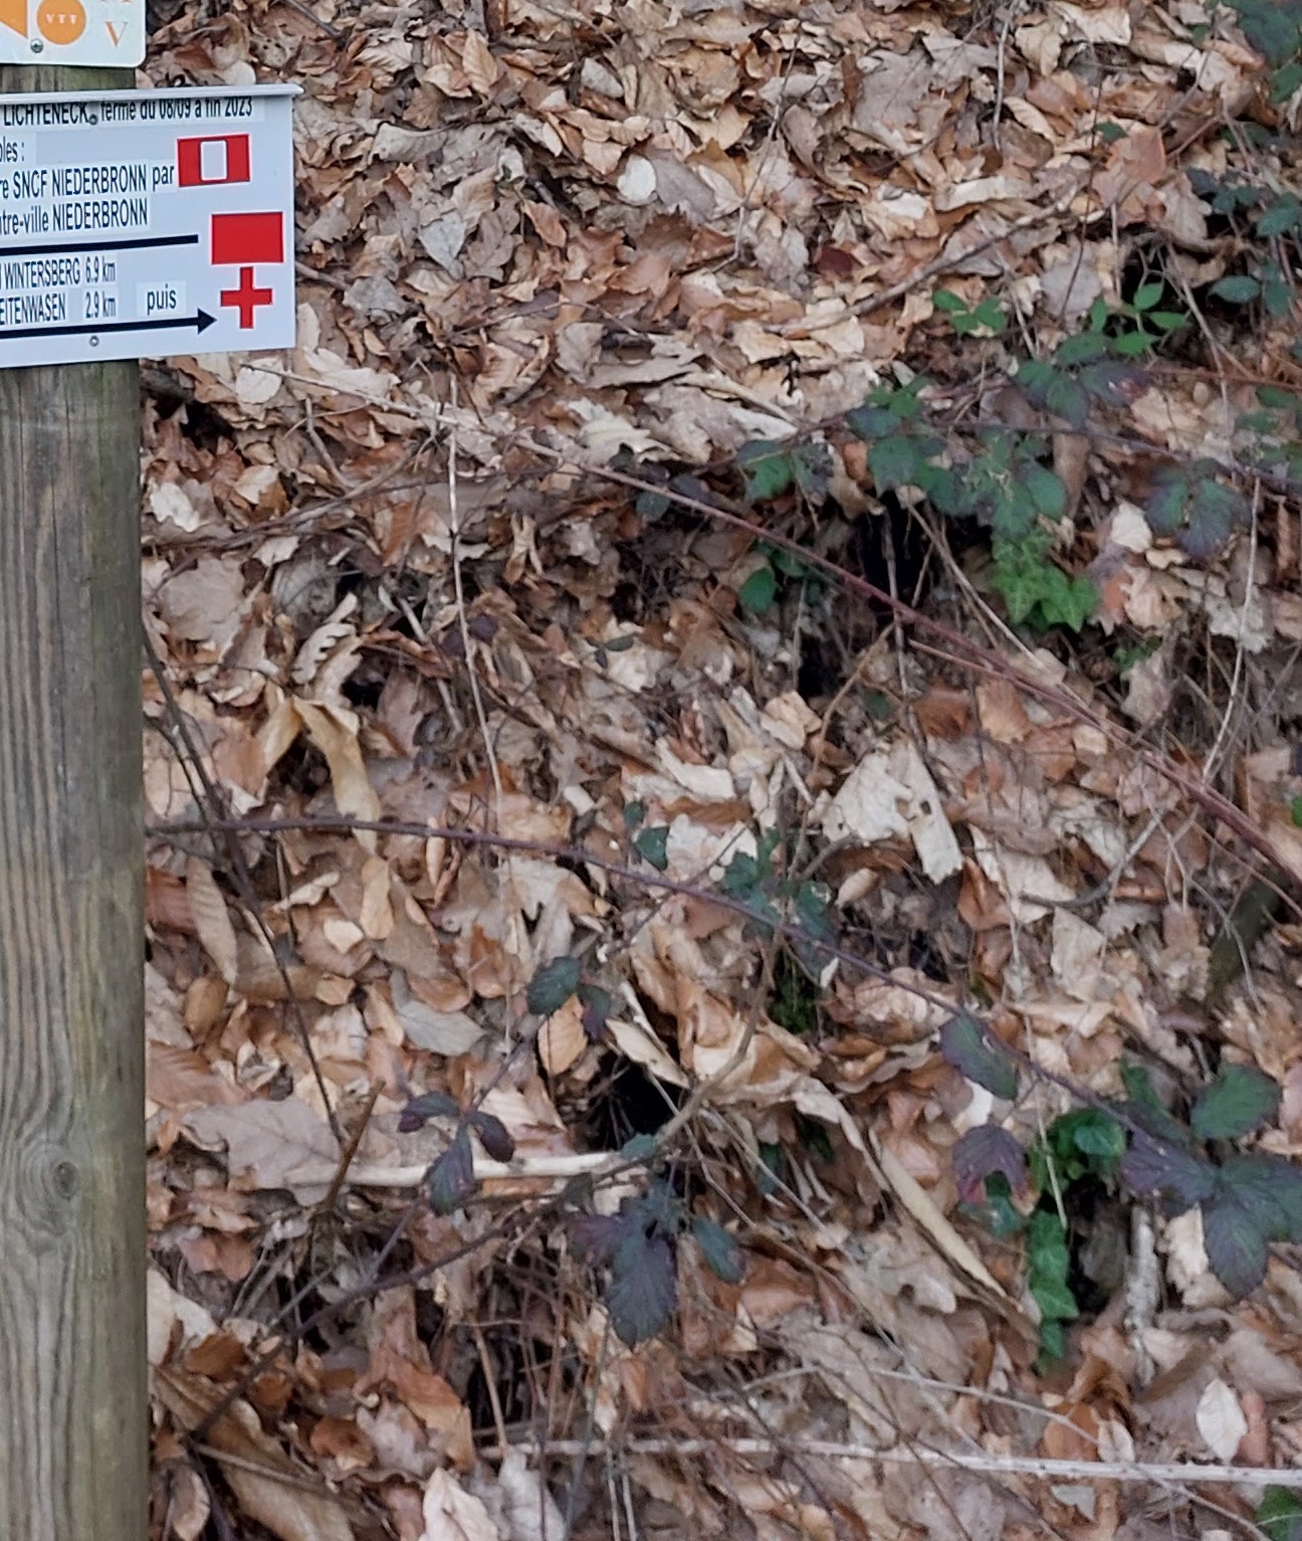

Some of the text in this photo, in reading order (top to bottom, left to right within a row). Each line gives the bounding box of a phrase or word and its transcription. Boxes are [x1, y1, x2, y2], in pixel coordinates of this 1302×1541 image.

[140, 98, 156, 120] du
[224, 95, 253, 118] 2023
[13, 169, 48, 200] SNCF
[52, 164, 147, 197] NIEDERBRONN
[152, 165, 175, 193] par
[52, 197, 148, 232] NIEDERBRONN
[4, 256, 81, 291] WINTERSBERG
[85, 255, 100, 284] 6.9
[102, 255, 117, 283] km
[85, 290, 100, 319] 2.9
[102, 289, 117, 318] km
[146, 283, 178, 316] puis
